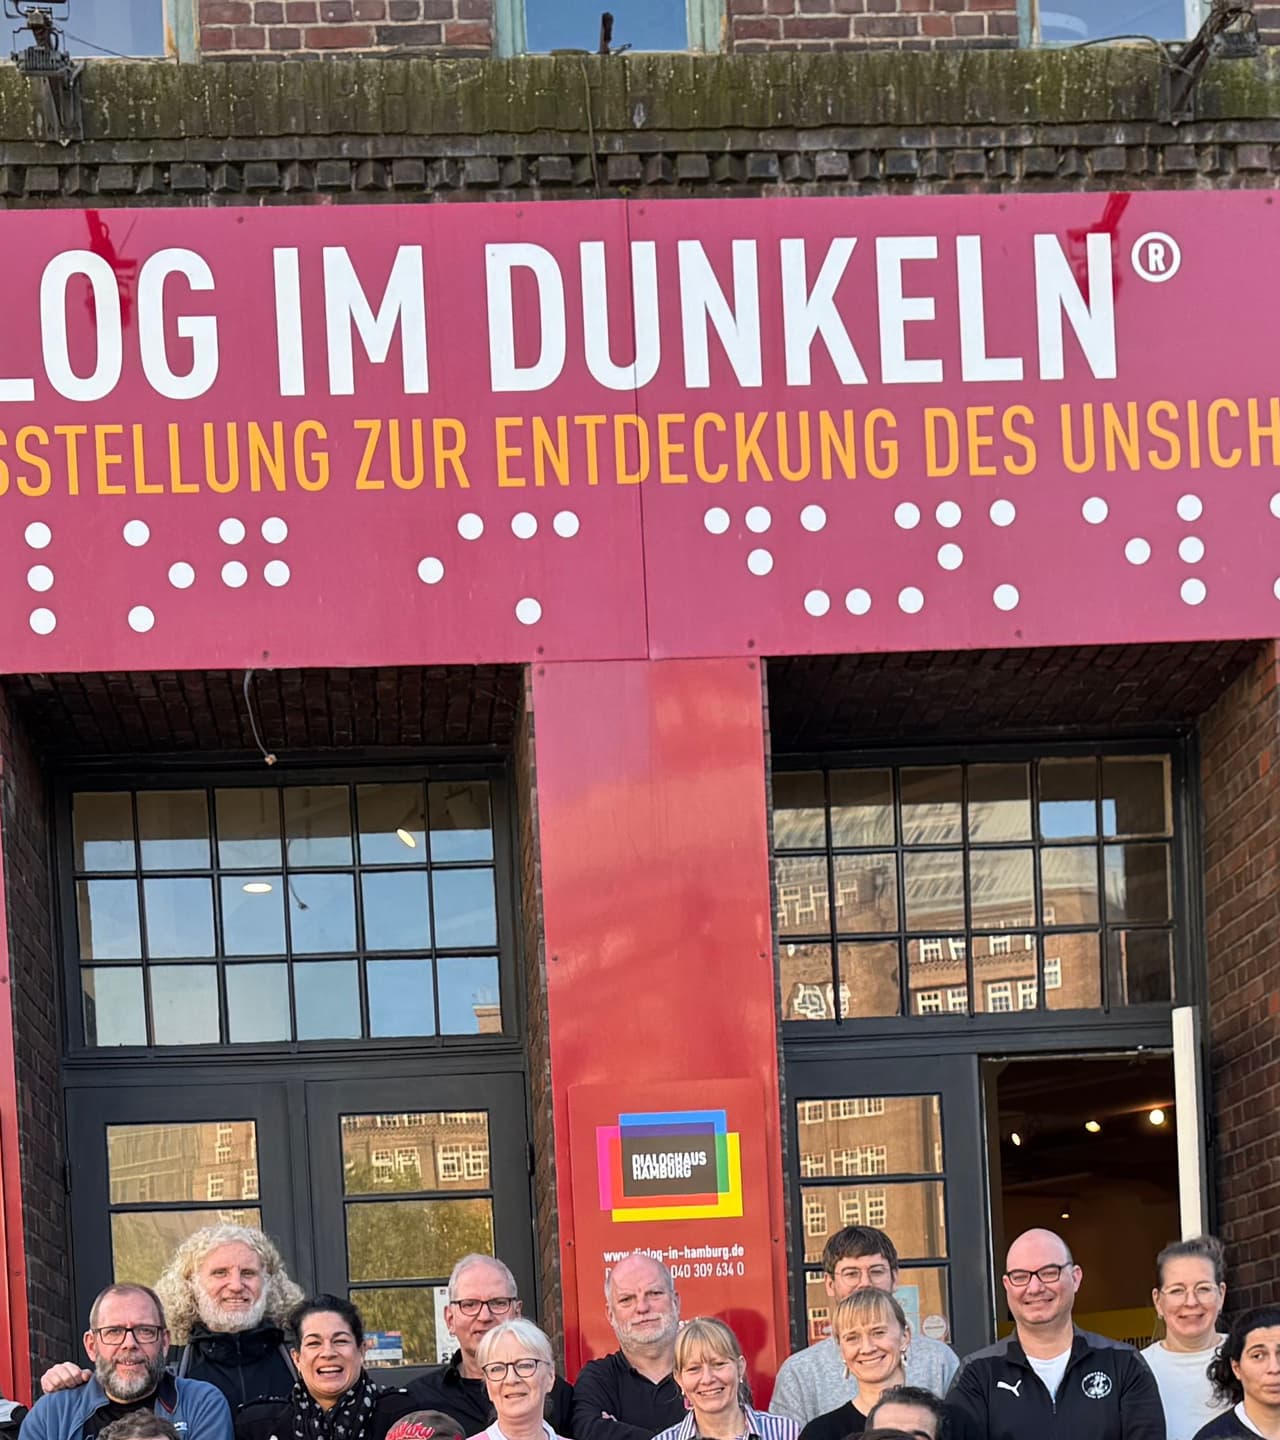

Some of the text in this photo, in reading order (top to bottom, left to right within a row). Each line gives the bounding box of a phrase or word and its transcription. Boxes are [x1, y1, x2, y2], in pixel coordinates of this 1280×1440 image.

[273, 245, 429, 396] IM
[353, 418, 470, 490] ZUR
[495, 407, 899, 488] ENTDECKUNG
[924, 404, 1037, 478] DES
[631, 1151, 708, 1168] DIALOGHAUS
[632, 1164, 692, 1180] HAMBURG
[603, 1243, 745, 1263] wwwalog-in-hamburg.de
[671, 1260, 745, 1279] 040 309 634 0
